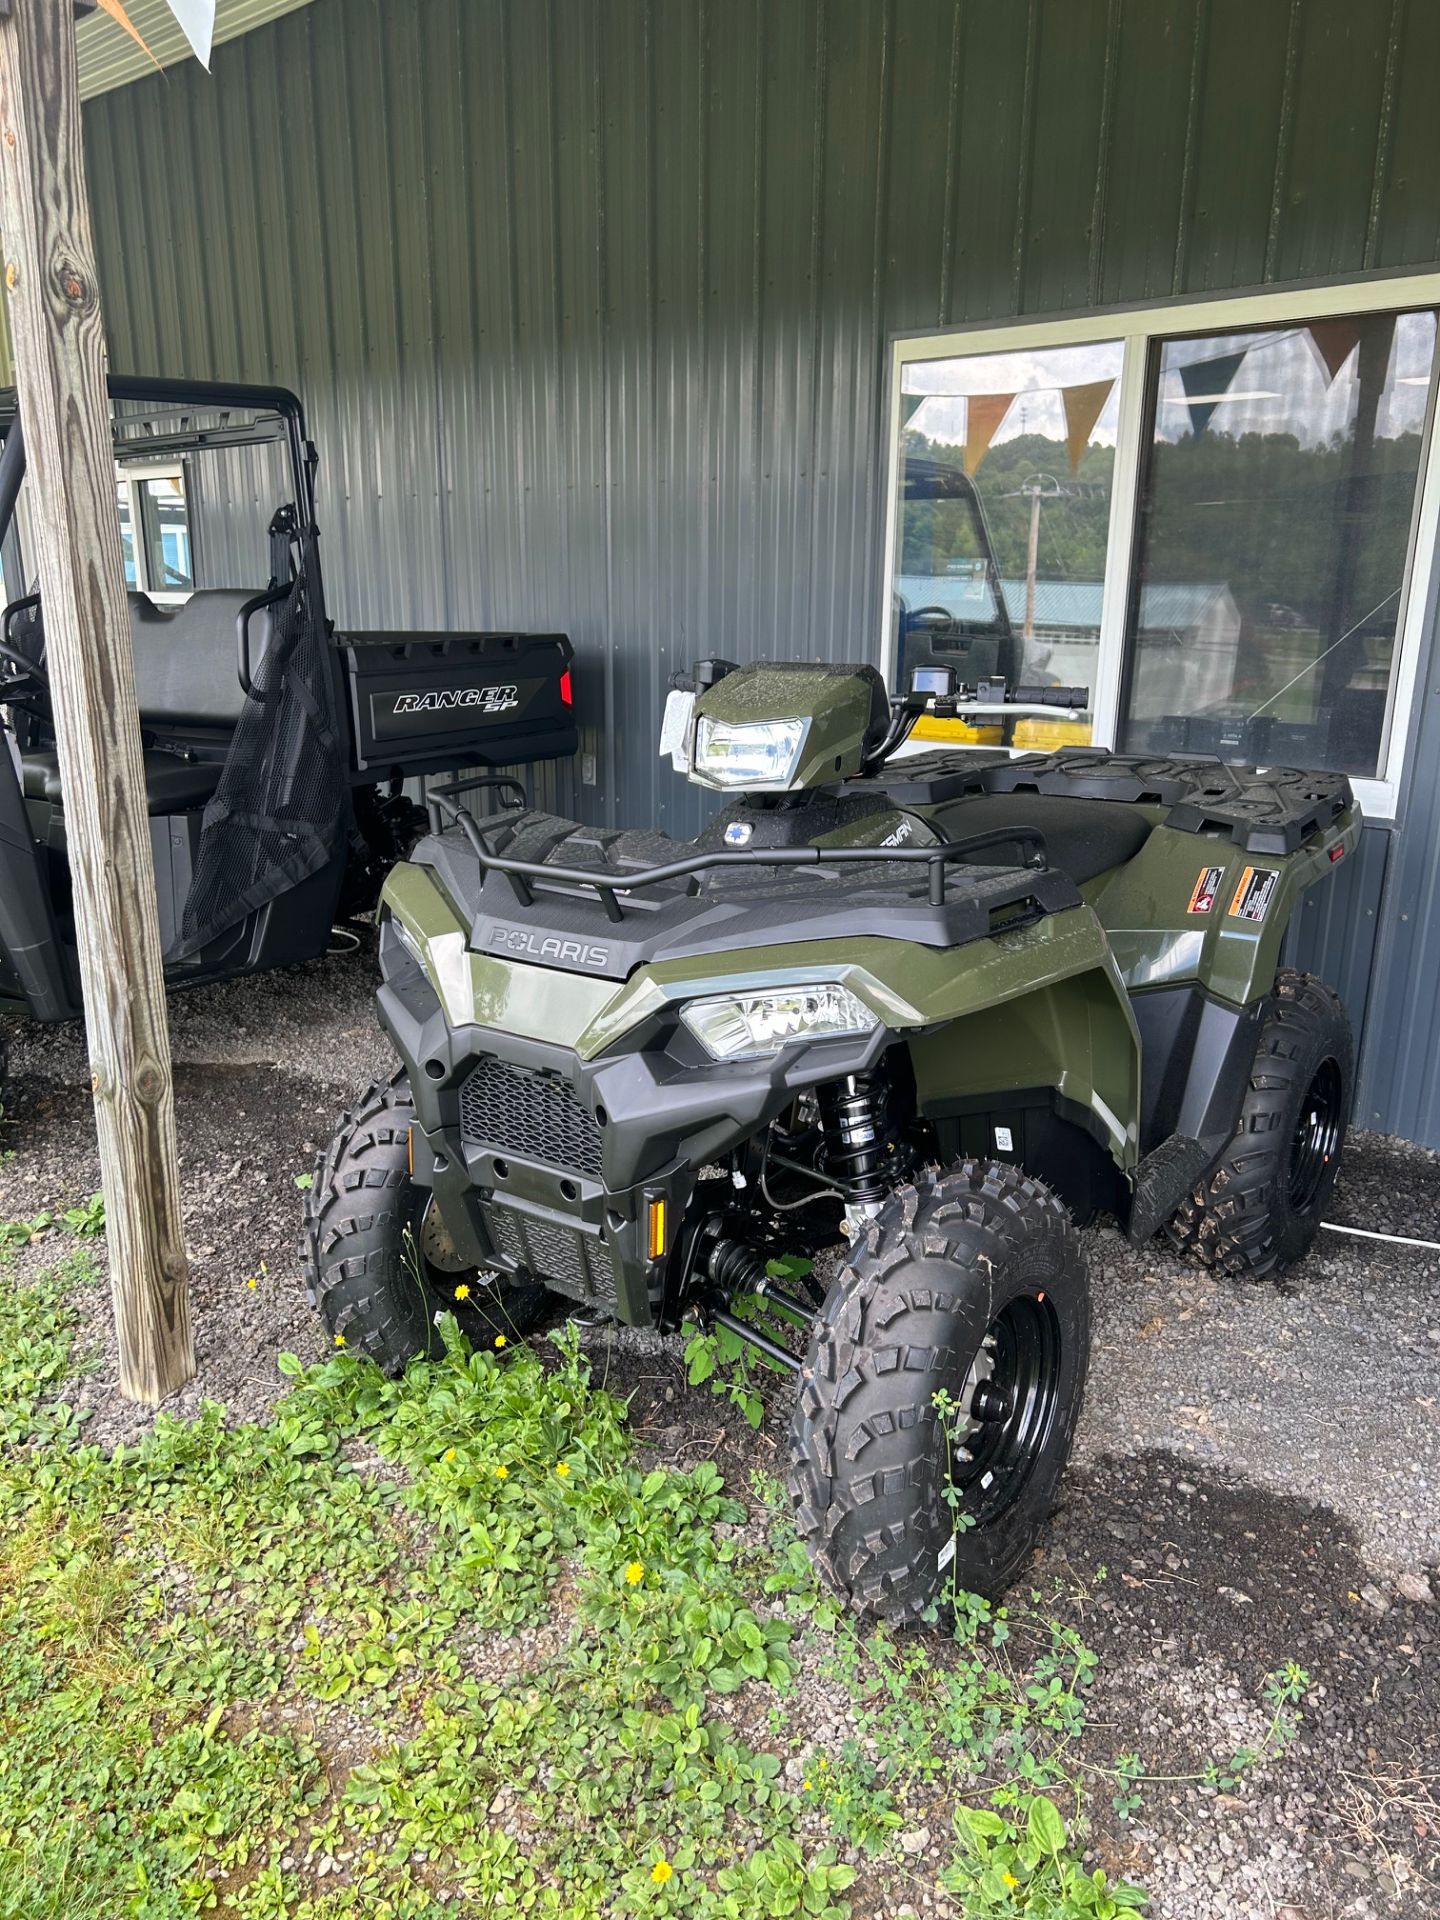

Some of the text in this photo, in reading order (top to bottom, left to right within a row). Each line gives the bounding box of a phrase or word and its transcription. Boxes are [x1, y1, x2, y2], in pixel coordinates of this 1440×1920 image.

[393, 685, 517, 713] RANGER
[483, 700, 519, 713] SP
[488, 926, 609, 968] POLARIS
